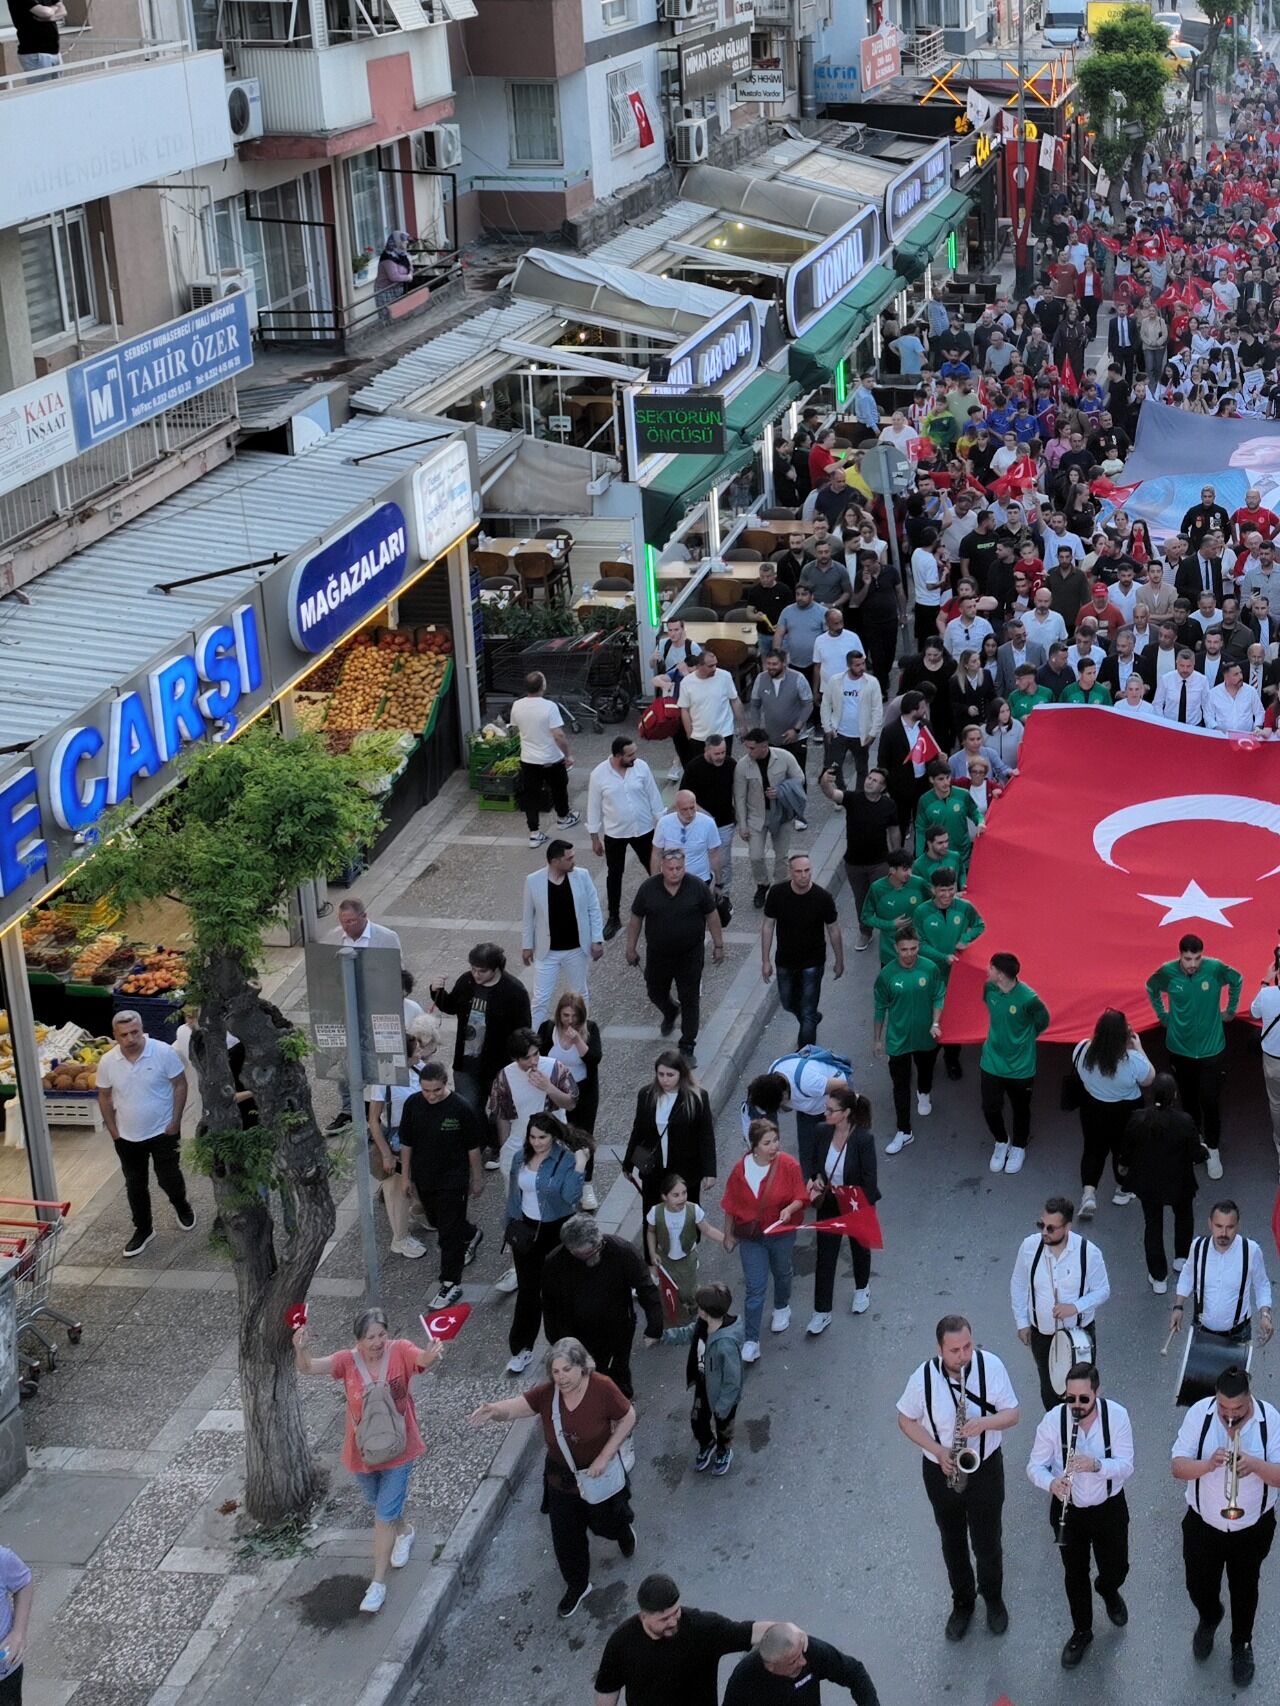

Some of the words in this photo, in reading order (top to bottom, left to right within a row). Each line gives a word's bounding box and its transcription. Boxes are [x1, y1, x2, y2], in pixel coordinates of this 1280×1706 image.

[813, 228, 864, 309] KONYALI
[127, 347, 189, 398] TAHİR
[191, 324, 240, 367] ÖZER
[721, 332, 738, 371] 80
[737, 320, 752, 357] 44
[24, 391, 64, 424] KATA
[90, 384, 115, 425] M
[636, 407, 721, 425] SEKTÖRÜN
[26, 411, 67, 445] İNŞAAT
[647, 426, 713, 443] ÖNCÜSÜ
[300, 527, 405, 632] MAĞAZALARI
